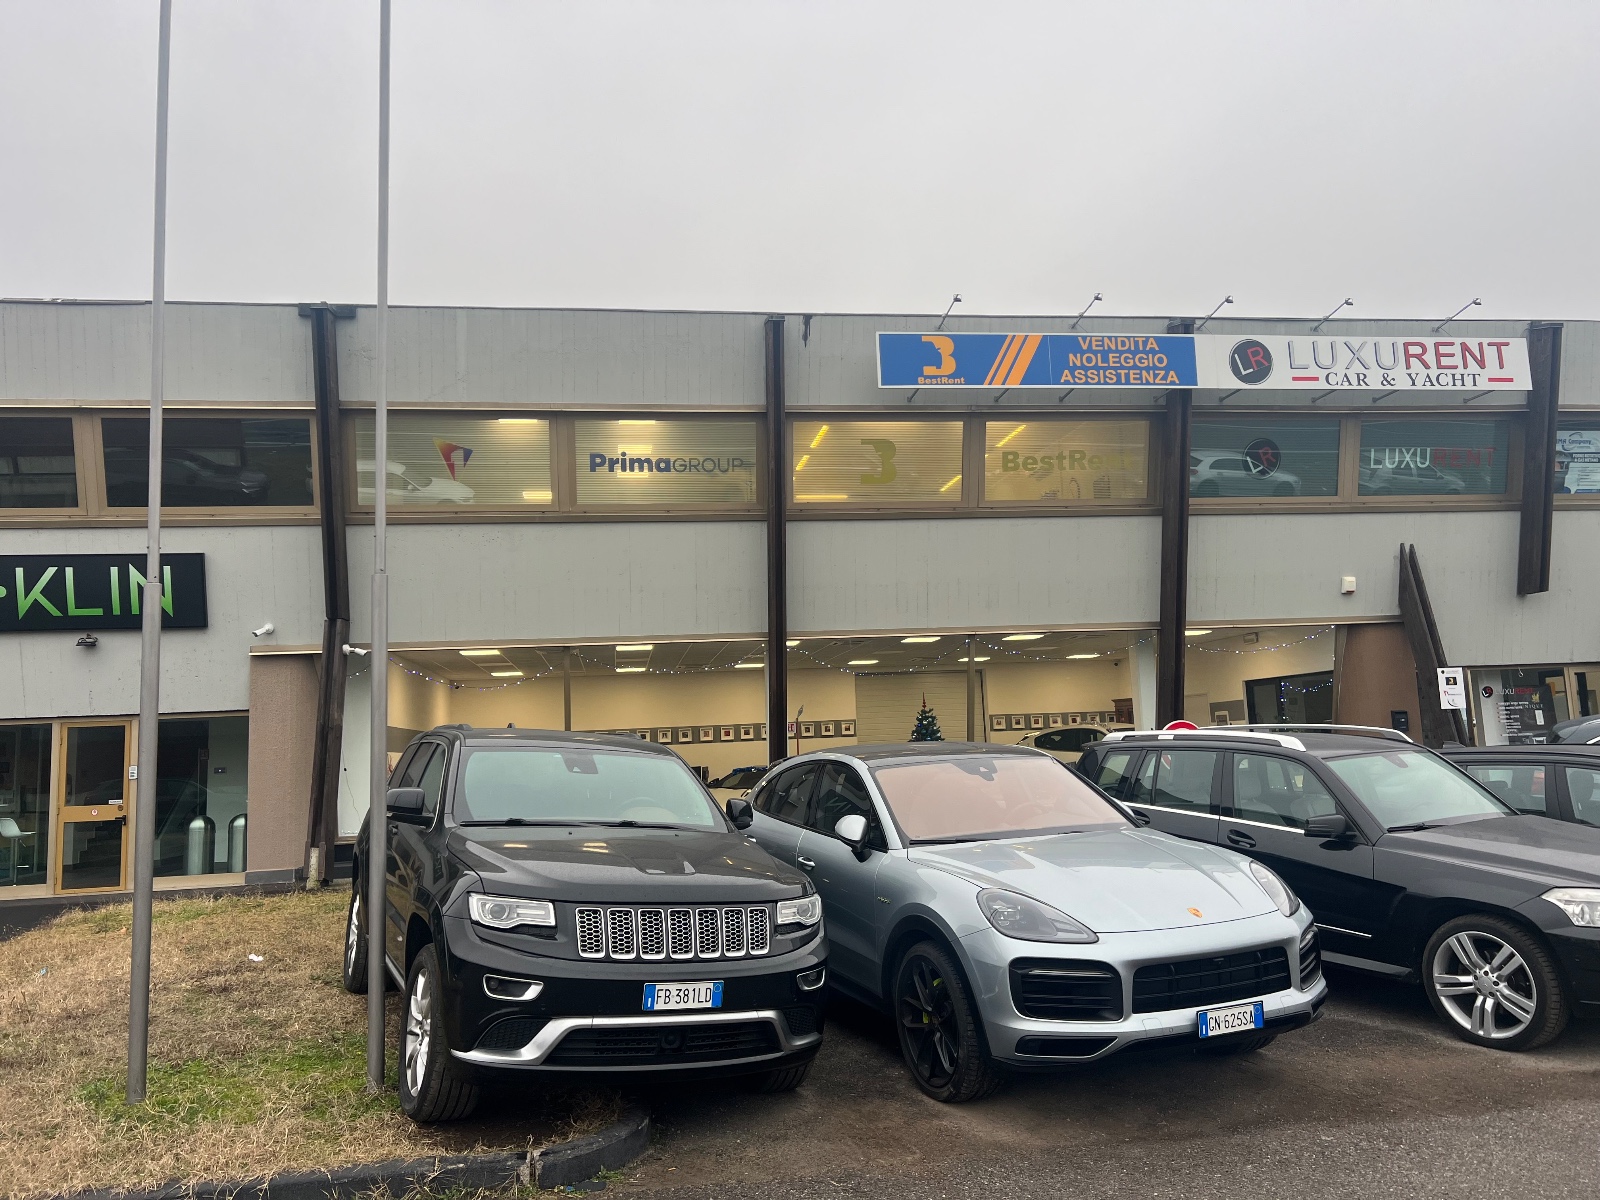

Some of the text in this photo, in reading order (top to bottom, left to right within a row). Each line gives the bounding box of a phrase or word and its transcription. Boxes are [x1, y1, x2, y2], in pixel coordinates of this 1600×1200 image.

[1078, 337, 1159, 351] VENDITA
[1068, 353, 1168, 368] NOLEGGIO
[1287, 340, 1510, 370] LUXURENT
[917, 376, 965, 385] BestRent
[1060, 369, 1180, 384] ASSISTENZA
[1324, 372, 1481, 387] CAR & YACHT
[1370, 447, 1496, 469] LUXURENT
[656, 987, 712, 1005] FB 381LD
[1208, 1010, 1255, 1032] GN 625SA
